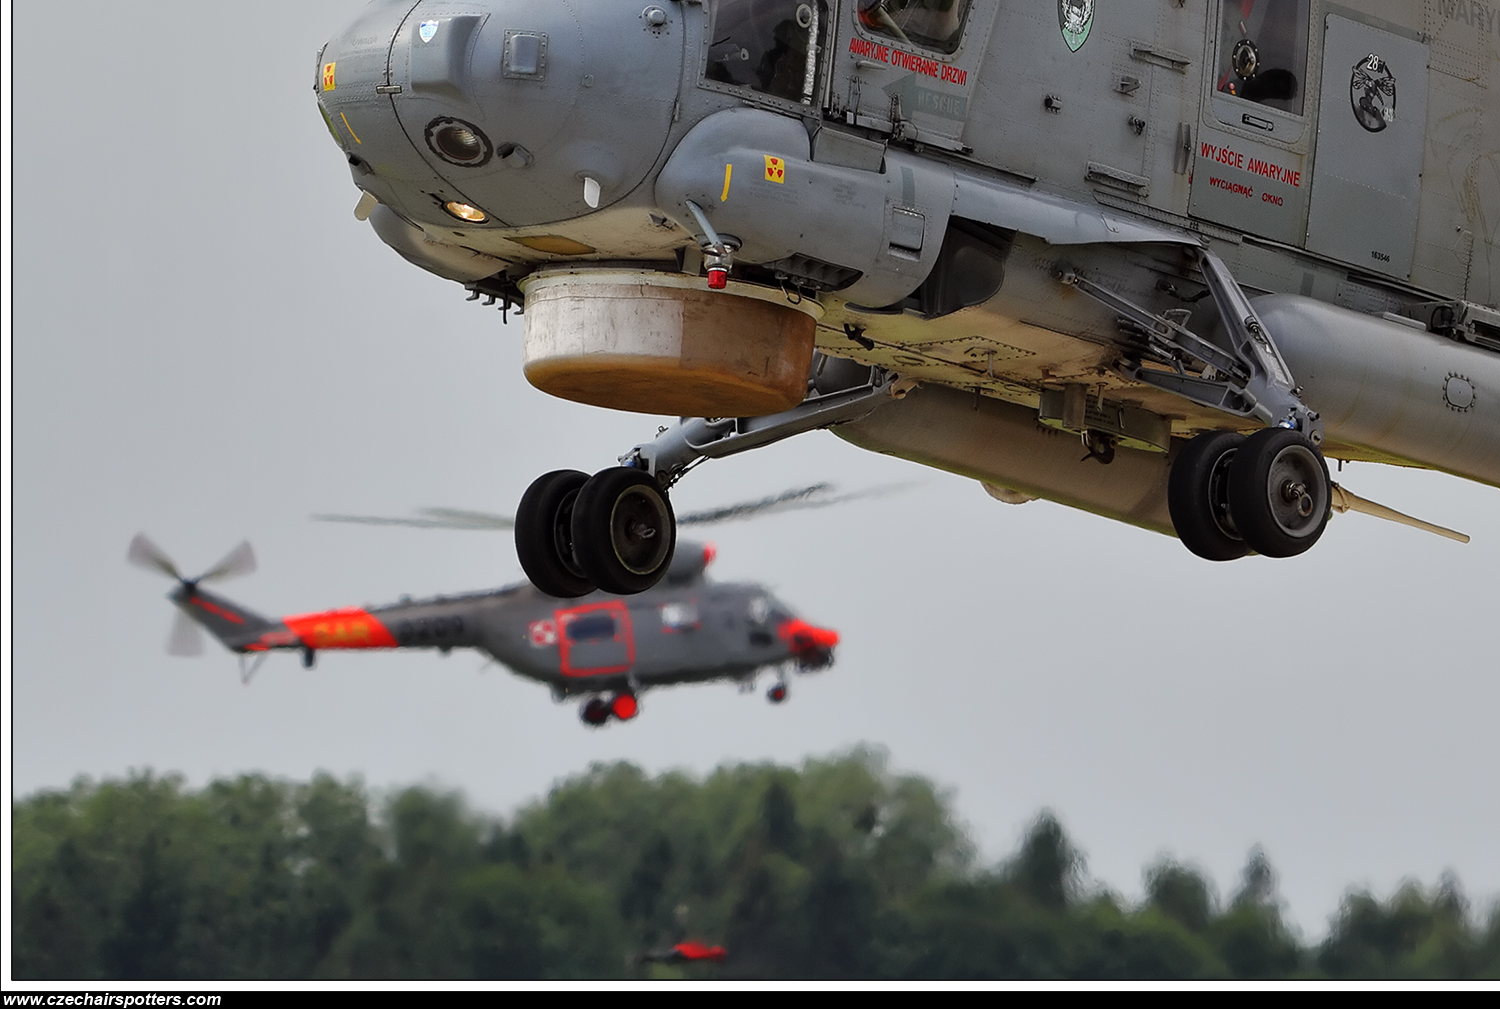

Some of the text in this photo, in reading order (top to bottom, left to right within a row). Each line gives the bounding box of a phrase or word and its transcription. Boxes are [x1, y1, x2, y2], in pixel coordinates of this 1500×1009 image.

[849, 38, 967, 86] AWARYJNE OTWIERANIE DRZWI
[1366, 53, 1379, 71] 28
[918, 90, 961, 116] RESCUE
[1201, 142, 1300, 187] WYJŚCIE AWARYJNE
[1209, 176, 1283, 206] WYCIĄGNĄĆ OKNO
[1371, 250, 1390, 262] 163546
